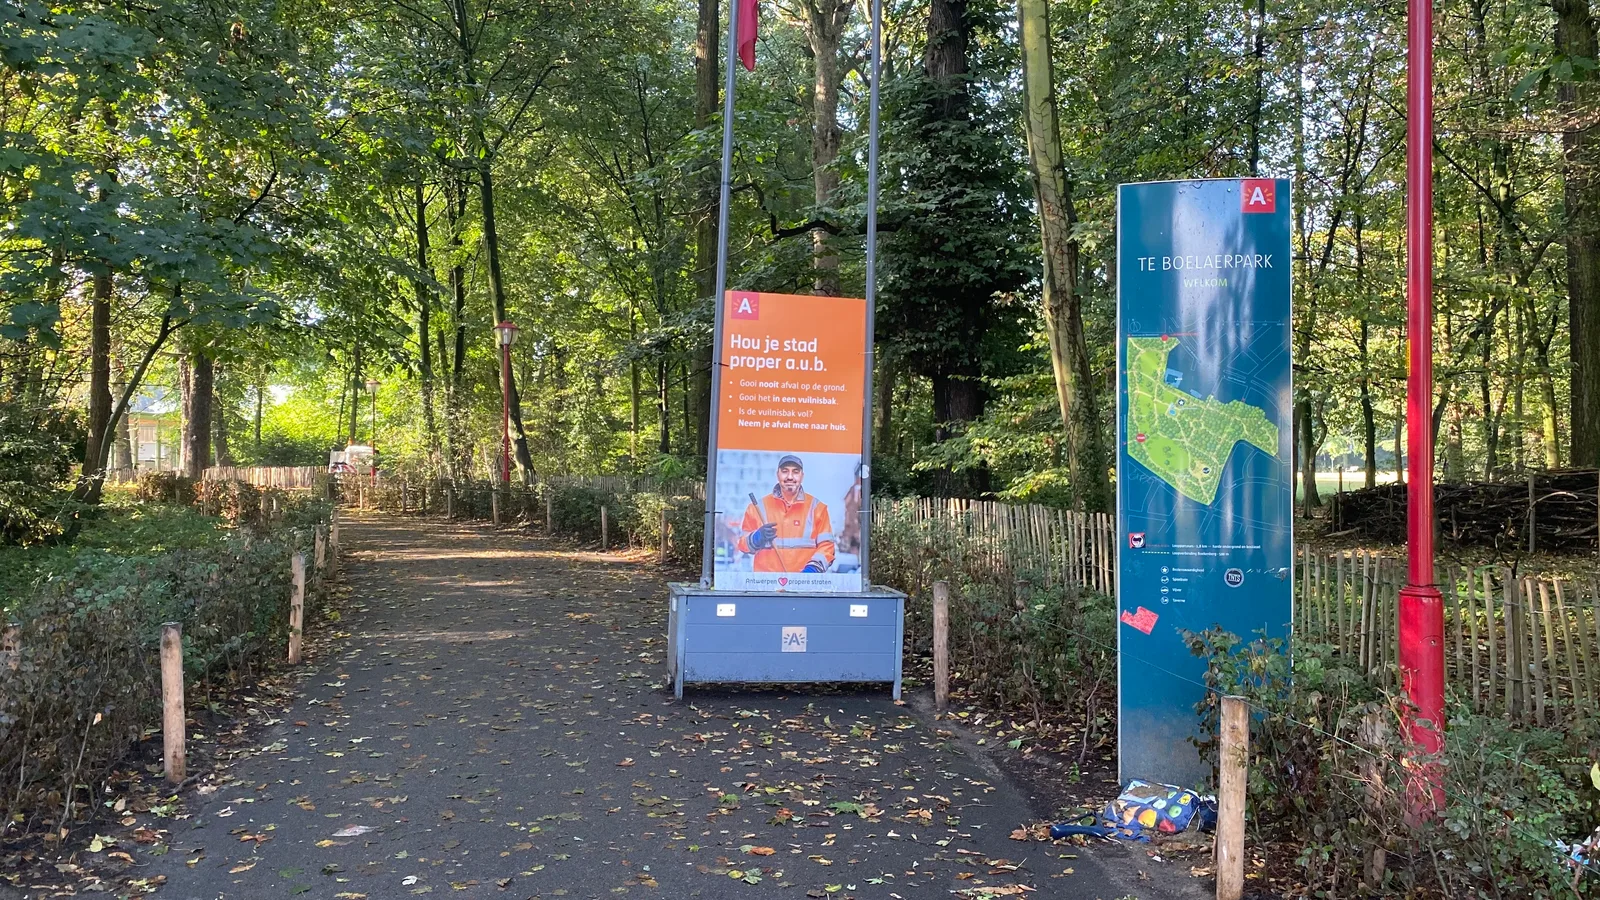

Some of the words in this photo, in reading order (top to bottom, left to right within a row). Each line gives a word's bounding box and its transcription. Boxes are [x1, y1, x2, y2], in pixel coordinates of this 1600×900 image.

[1249, 187, 1266, 205] A
[1137, 257, 1156, 271] TE
[1162, 254, 1273, 271] BOELAERPARK
[1183, 278, 1228, 288] WELKOM
[738, 298, 752, 314] A
[730, 333, 760, 350] Hou
[763, 335, 779, 353] je
[783, 337, 818, 353] stad
[729, 355, 781, 371] proper
[785, 356, 827, 372] a.u.b.
[740, 379, 757, 388] Gooi
[759, 380, 779, 389] nooit
[781, 381, 799, 390] afval
[801, 383, 810, 392] op
[812, 382, 821, 391] de
[823, 383, 847, 393] grond.
[739, 393, 756, 401] Gooi
[758, 393, 770, 402] het
[772, 394, 780, 402] in
[798, 395, 839, 405] vuilnisbak.
[738, 407, 745, 415] Is
[747, 407, 756, 415] de
[758, 408, 796, 417] vuilnisbak
[797, 409, 813, 418] vol?
[738, 419, 760, 428] Neem
[762, 419, 770, 429] je
[771, 420, 791, 429] afval
[830, 422, 848, 431] huis.
[788, 578, 810, 586] propere
